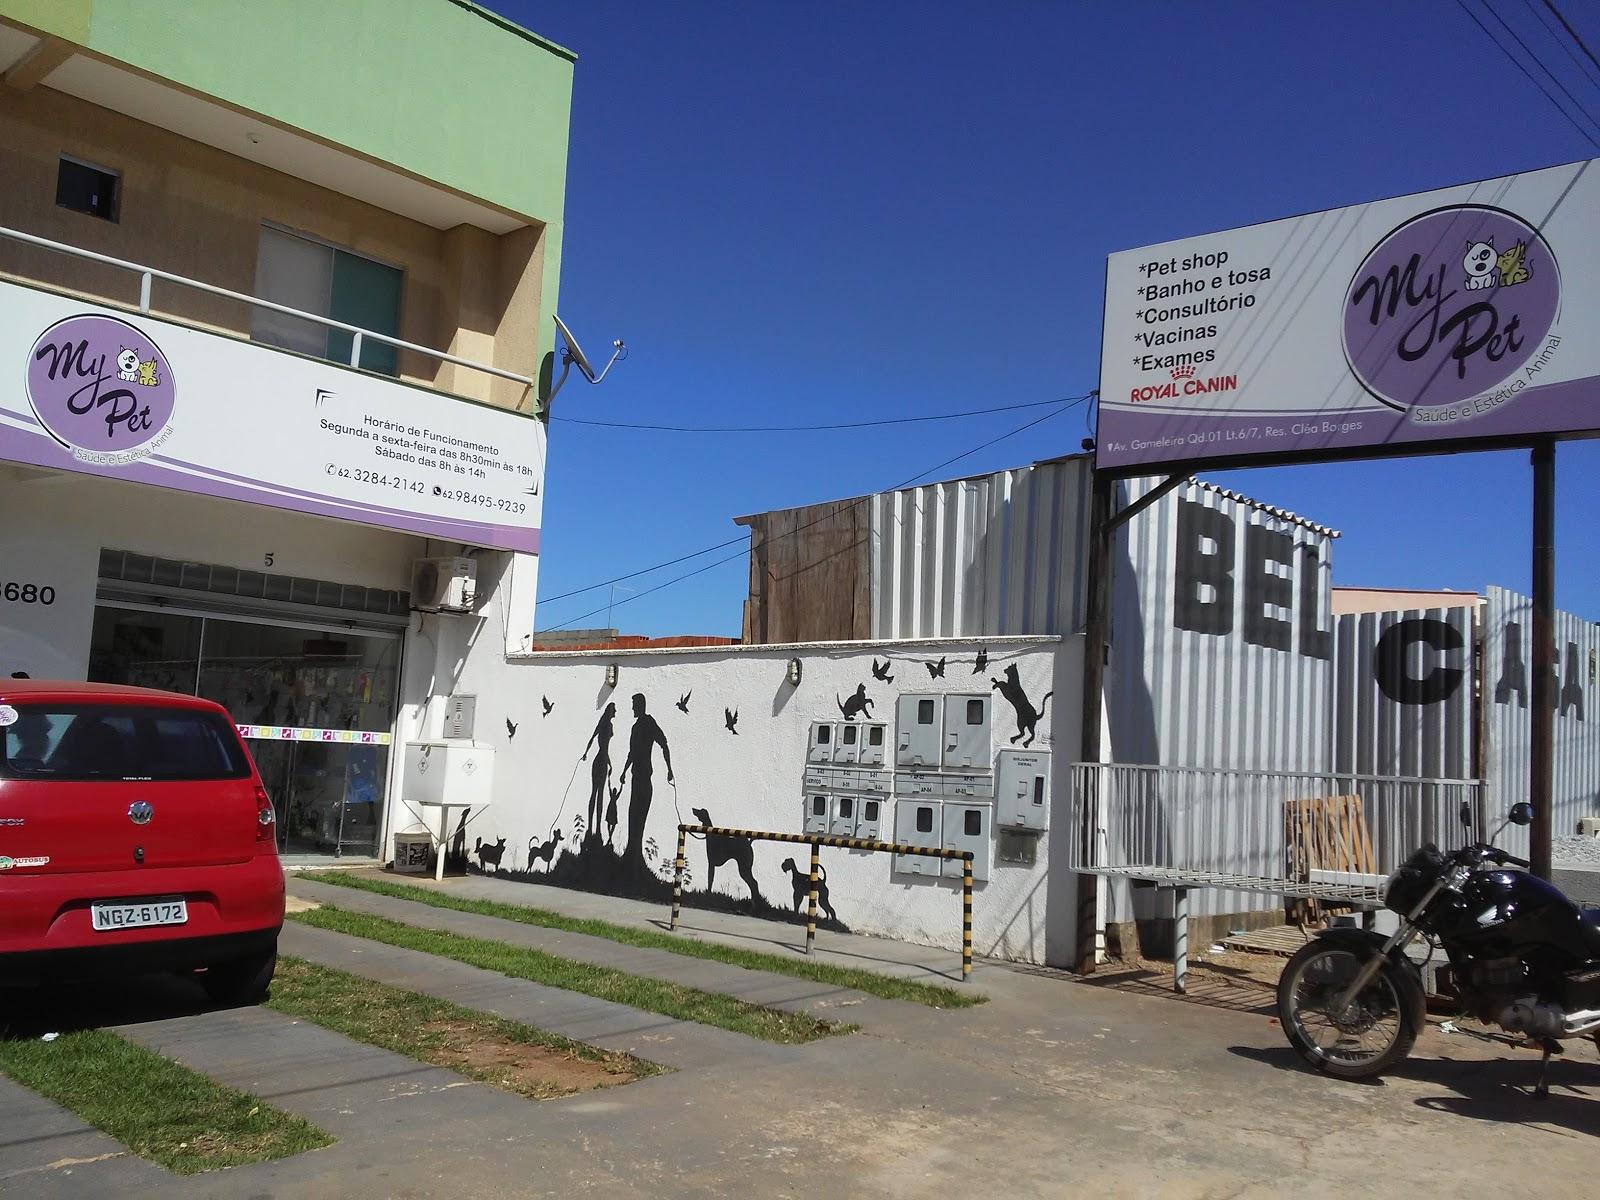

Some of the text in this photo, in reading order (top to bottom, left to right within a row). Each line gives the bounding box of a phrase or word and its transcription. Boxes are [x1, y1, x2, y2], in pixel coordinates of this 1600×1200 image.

[1181, 250, 1229, 271] shop
[1211, 276, 1223, 289] e
[1228, 267, 1271, 287] tosa
[1353, 253, 1457, 361] My
[1439, 301, 1525, 379] Pet
[36, 339, 112, 415] My
[1130, 374, 1238, 402] ROYAL CANIN
[1414, 334, 1563, 422] Saúde e Estética Animal
[97, 389, 152, 438] Pet
[76, 424, 174, 464] Saúde e Estética Animal
[320, 418, 533, 477] Segunda a sexta-feira das 8h30min às 18h
[364, 414, 499, 456] Horário de Funcionamento
[1131, 436, 1185, 450] Gameleira
[1265, 426, 1288, 437] Res.
[374, 445, 486, 479] Sábado das 8h às 14h
[263, 552, 274, 568] 5
[0, 581, 56, 606] 680
[1173, 496, 1585, 722] BEL CAA
